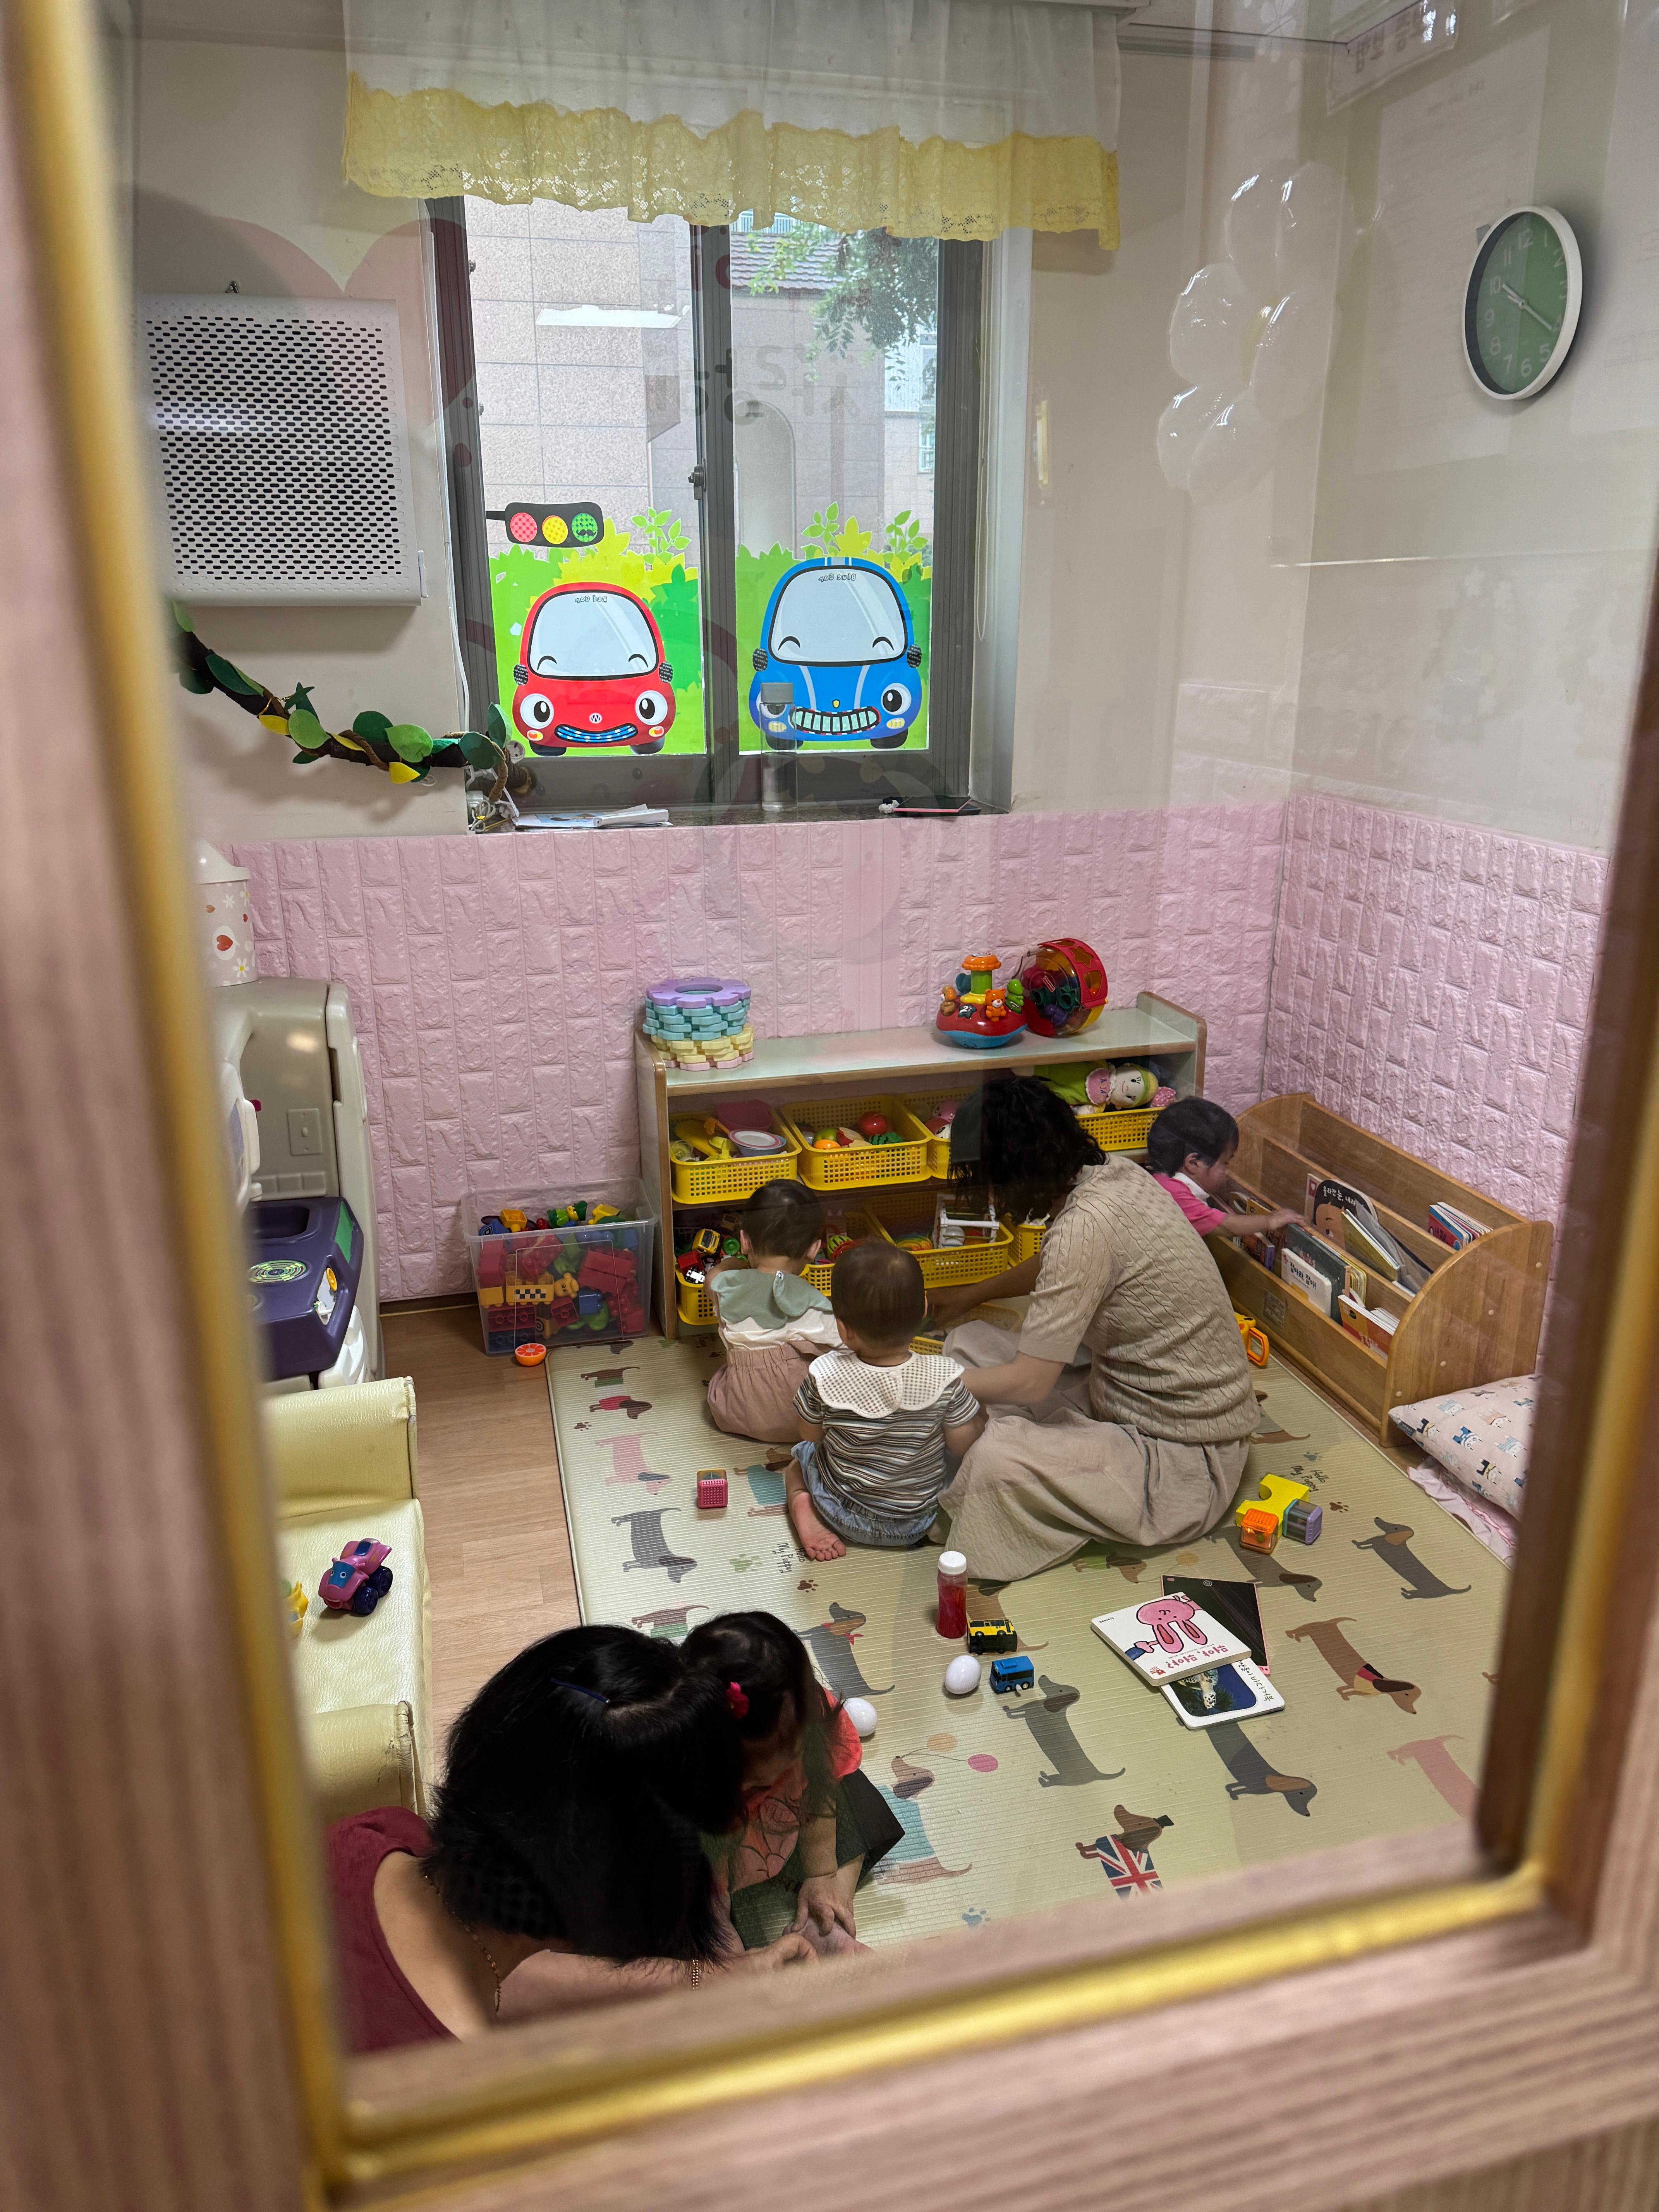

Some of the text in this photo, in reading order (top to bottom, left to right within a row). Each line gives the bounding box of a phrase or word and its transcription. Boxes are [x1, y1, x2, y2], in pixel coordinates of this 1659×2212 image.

[1518, 228, 1533, 249] 12
[1504, 249, 1511, 266] 11
[1553, 249, 1565, 267] 2
[1490, 276, 1501, 295] 10
[1485, 309, 1494, 328] 9
[1553, 314, 1562, 332] 4
[1490, 336, 1501, 356] 8
[1540, 343, 1549, 362] 5
[1503, 354, 1512, 374] 7
[1521, 358, 1532, 377] 6
[1323, 1186, 1336, 1197] 올라간
[1345, 1196, 1355, 1206] 내려
[1305, 1273, 1317, 1290] 잡아!
[1290, 1465, 1319, 1492] My Puppy
[1310, 1469, 1329, 1482] Hello
[772, 1543, 793, 1573] My Puppy
[795, 1548, 808, 1562] Hello
[1197, 1645, 1228, 1657] 뭐야,
[1166, 1654, 1197, 1668] 뭐야?
[1251, 1676, 1274, 1701] 바다거북
